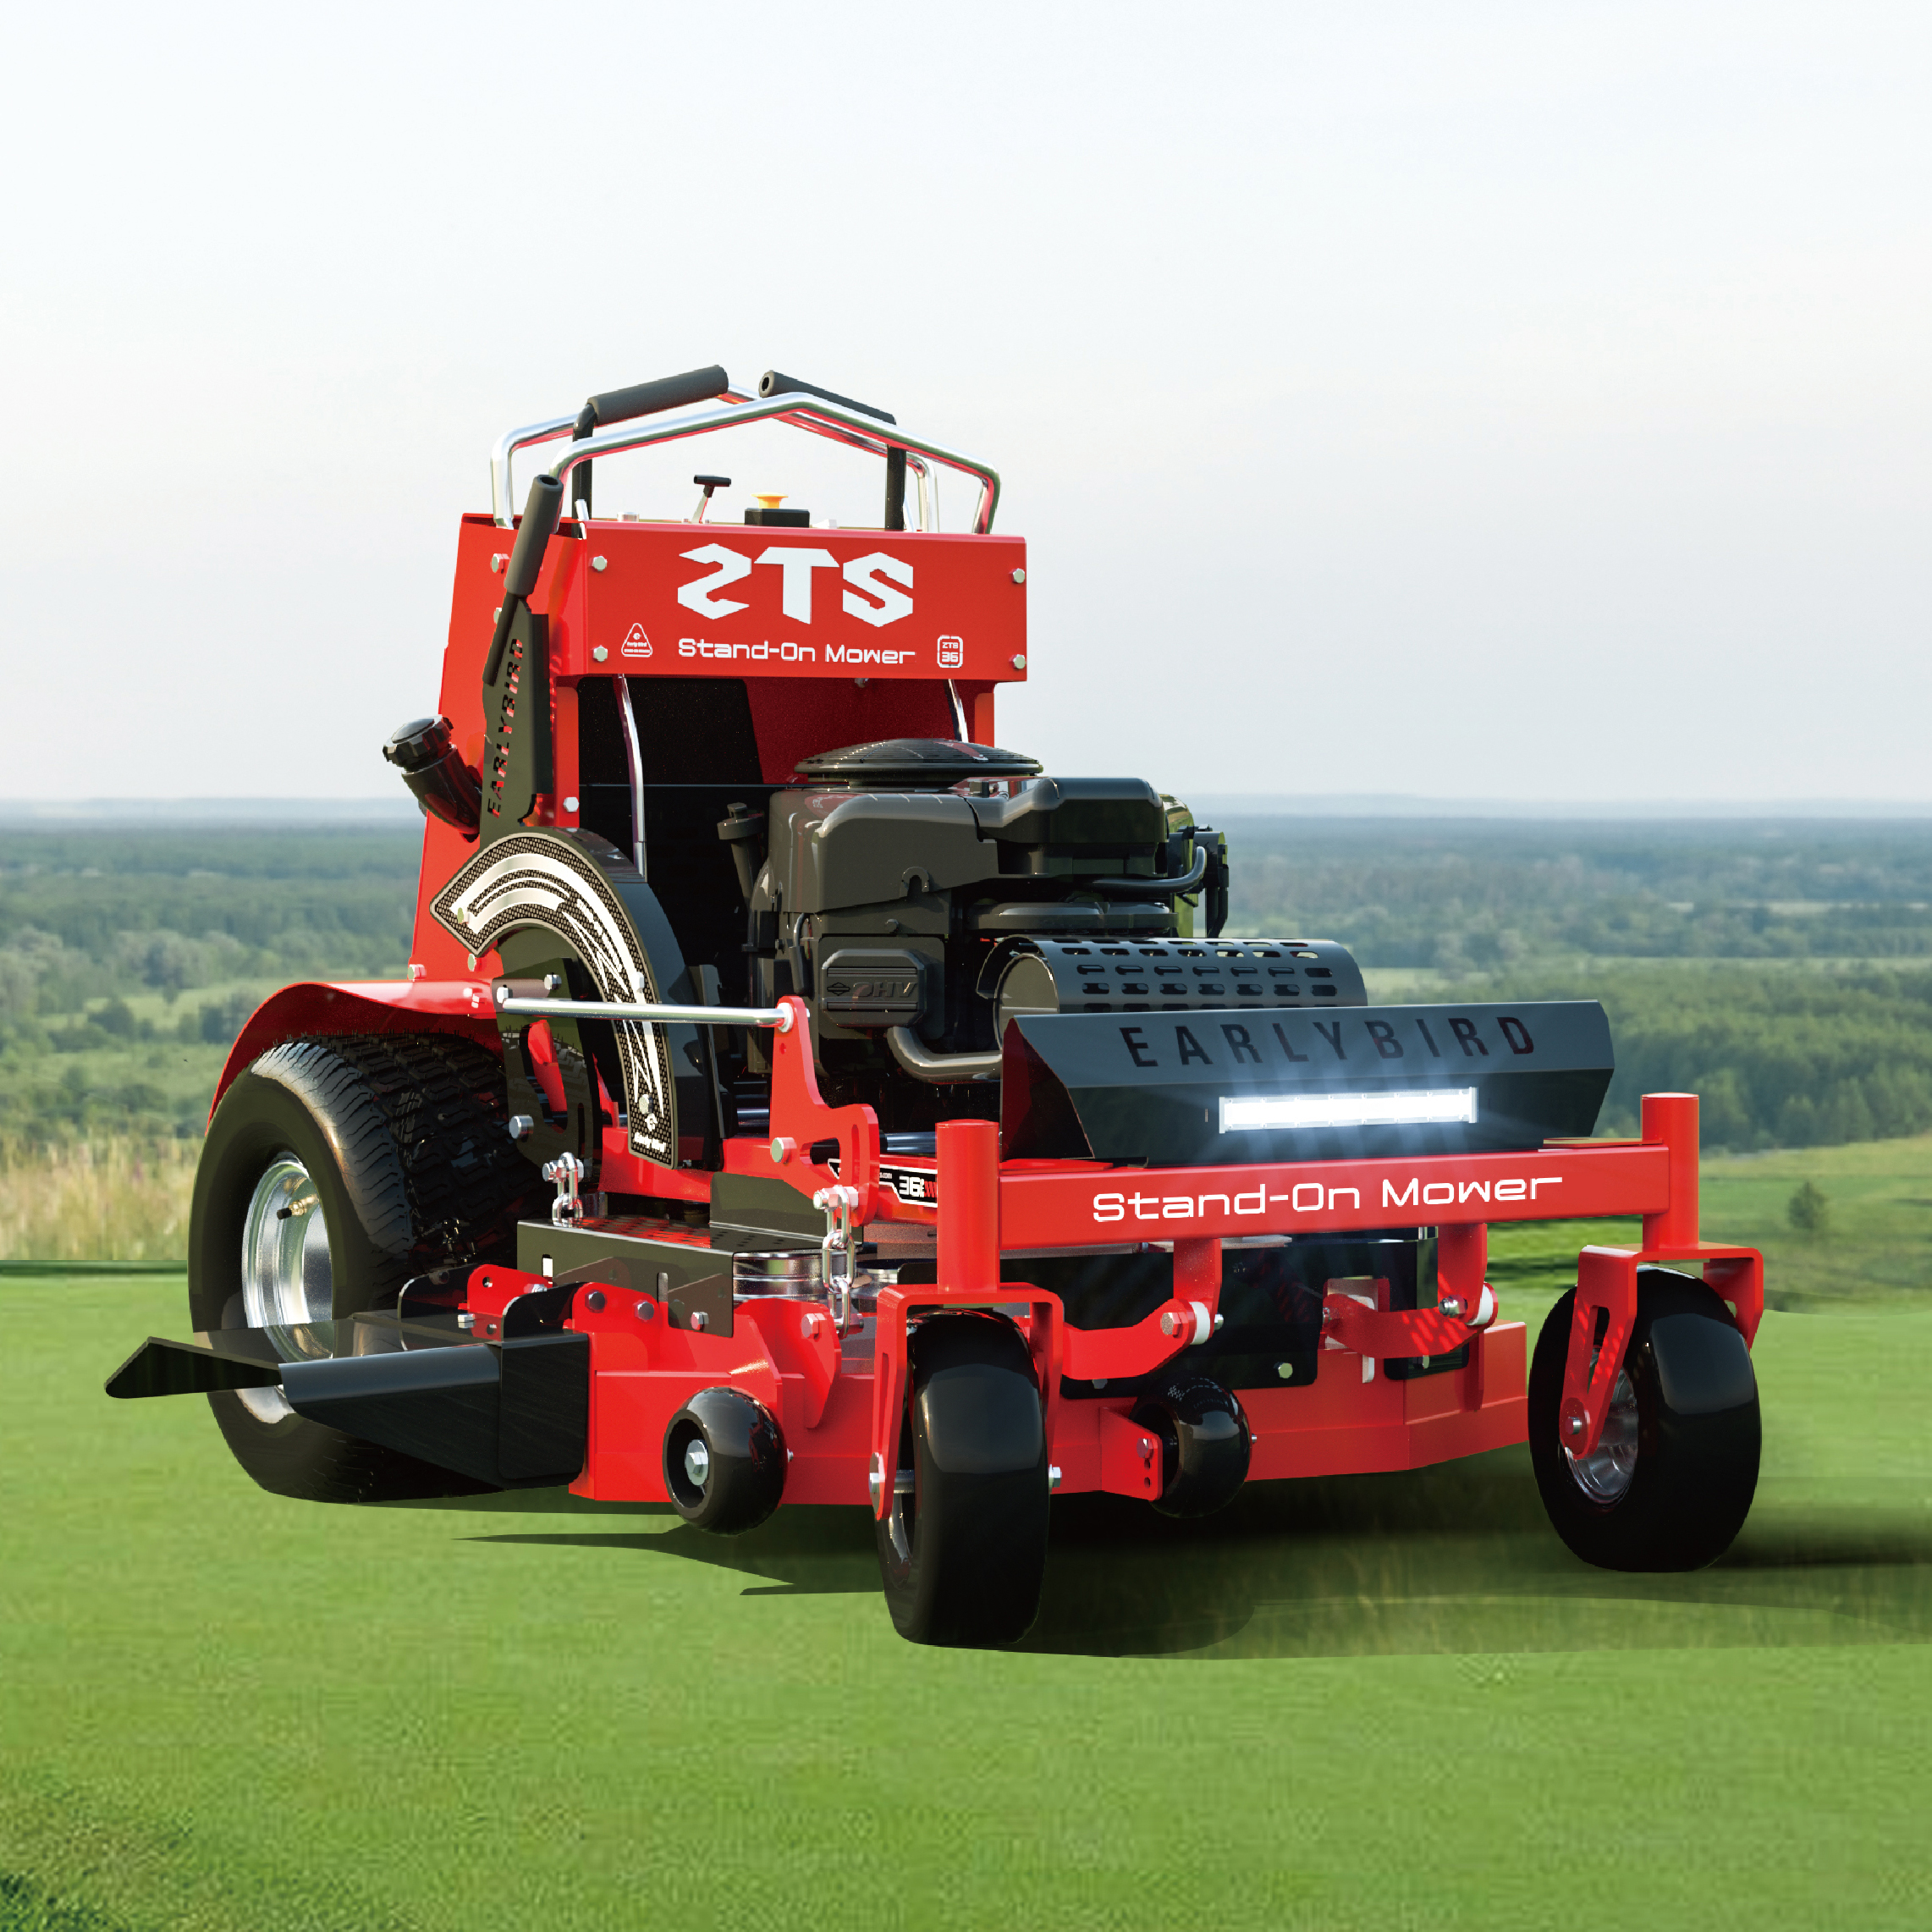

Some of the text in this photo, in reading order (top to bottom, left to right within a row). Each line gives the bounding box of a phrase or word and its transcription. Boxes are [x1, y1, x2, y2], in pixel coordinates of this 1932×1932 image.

[679, 638, 916, 664] Stand-On Mower
[941, 651, 959, 663] 36
[487, 639, 522, 818] EARLYBIRD
[1120, 1016, 1535, 1068] EARLYBIRD
[1093, 1177, 1563, 1223] Stand-On Mower
